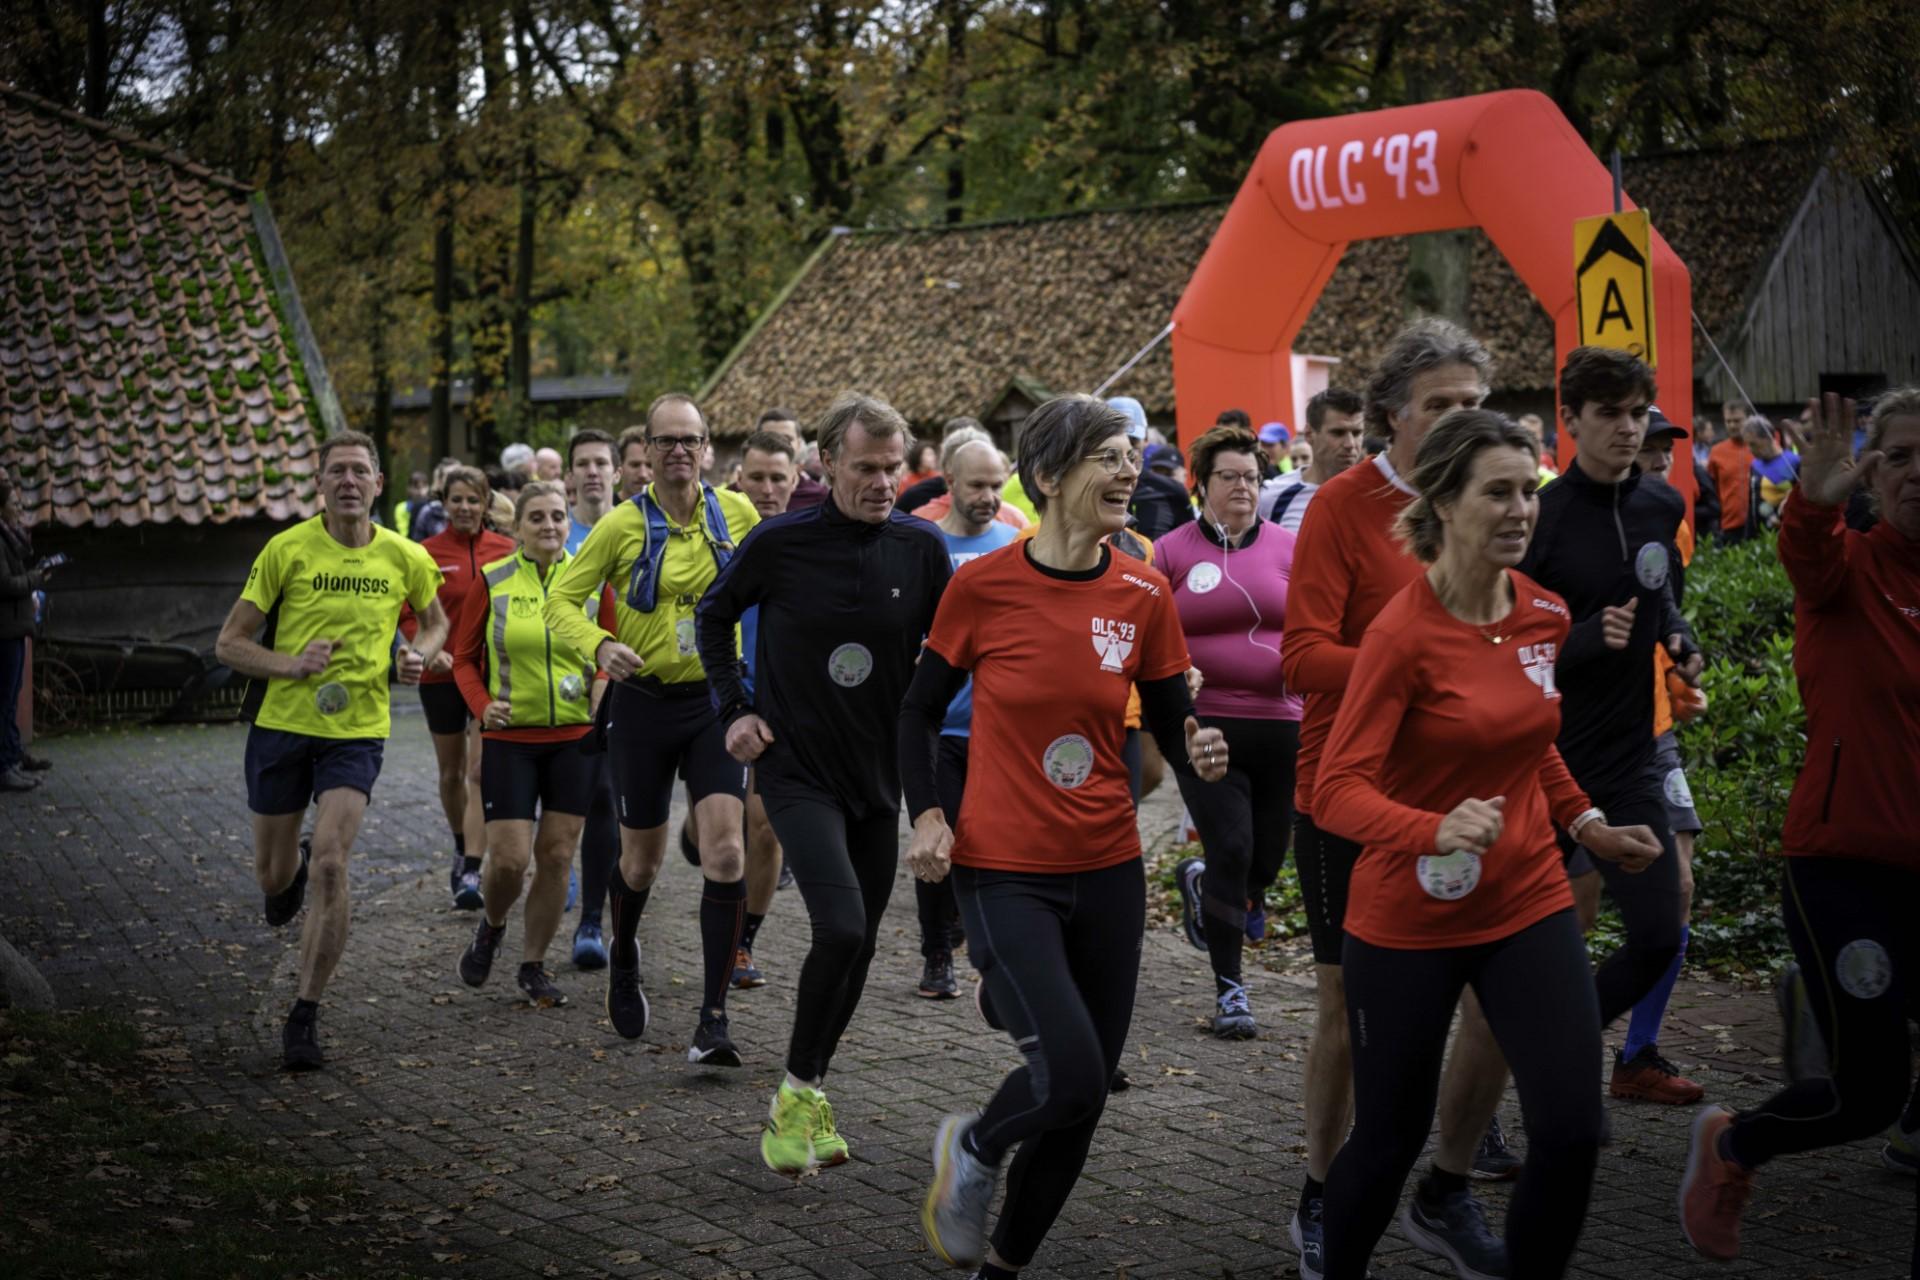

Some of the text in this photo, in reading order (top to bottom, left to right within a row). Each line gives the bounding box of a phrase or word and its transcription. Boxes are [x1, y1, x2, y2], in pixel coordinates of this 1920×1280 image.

[1289, 140, 1367, 211] OLC
[1596, 278, 1634, 335] A
[312, 572, 389, 595] dionysos
[1092, 617, 1116, 636] OLC
